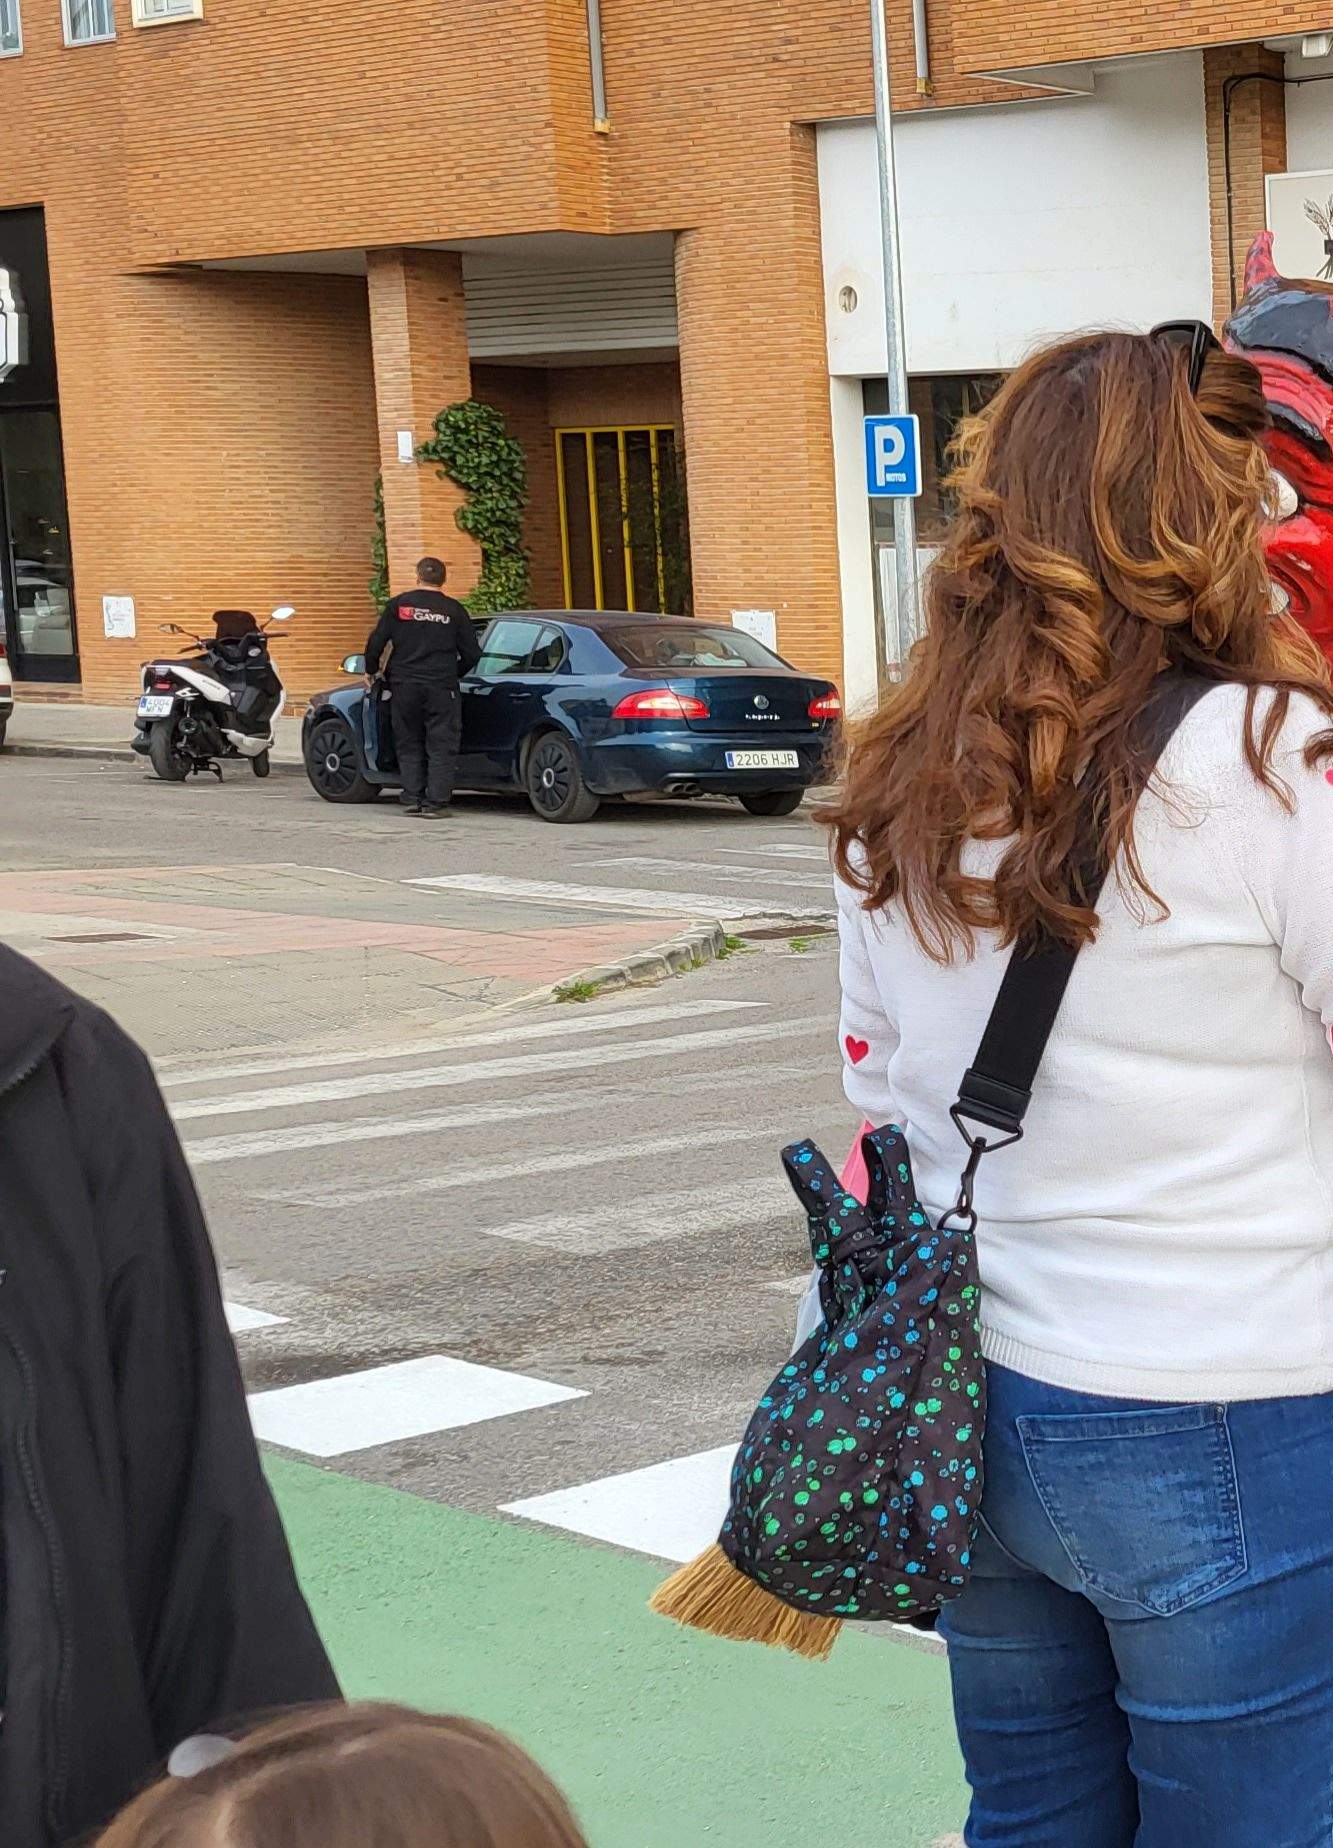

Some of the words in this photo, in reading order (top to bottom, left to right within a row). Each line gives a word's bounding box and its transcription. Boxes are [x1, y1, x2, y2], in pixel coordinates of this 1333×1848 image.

[874, 425, 905, 487] P
[413, 611, 450, 624] GAYPU
[736, 753, 768, 766] 2206
[772, 753, 795, 765] HJR
